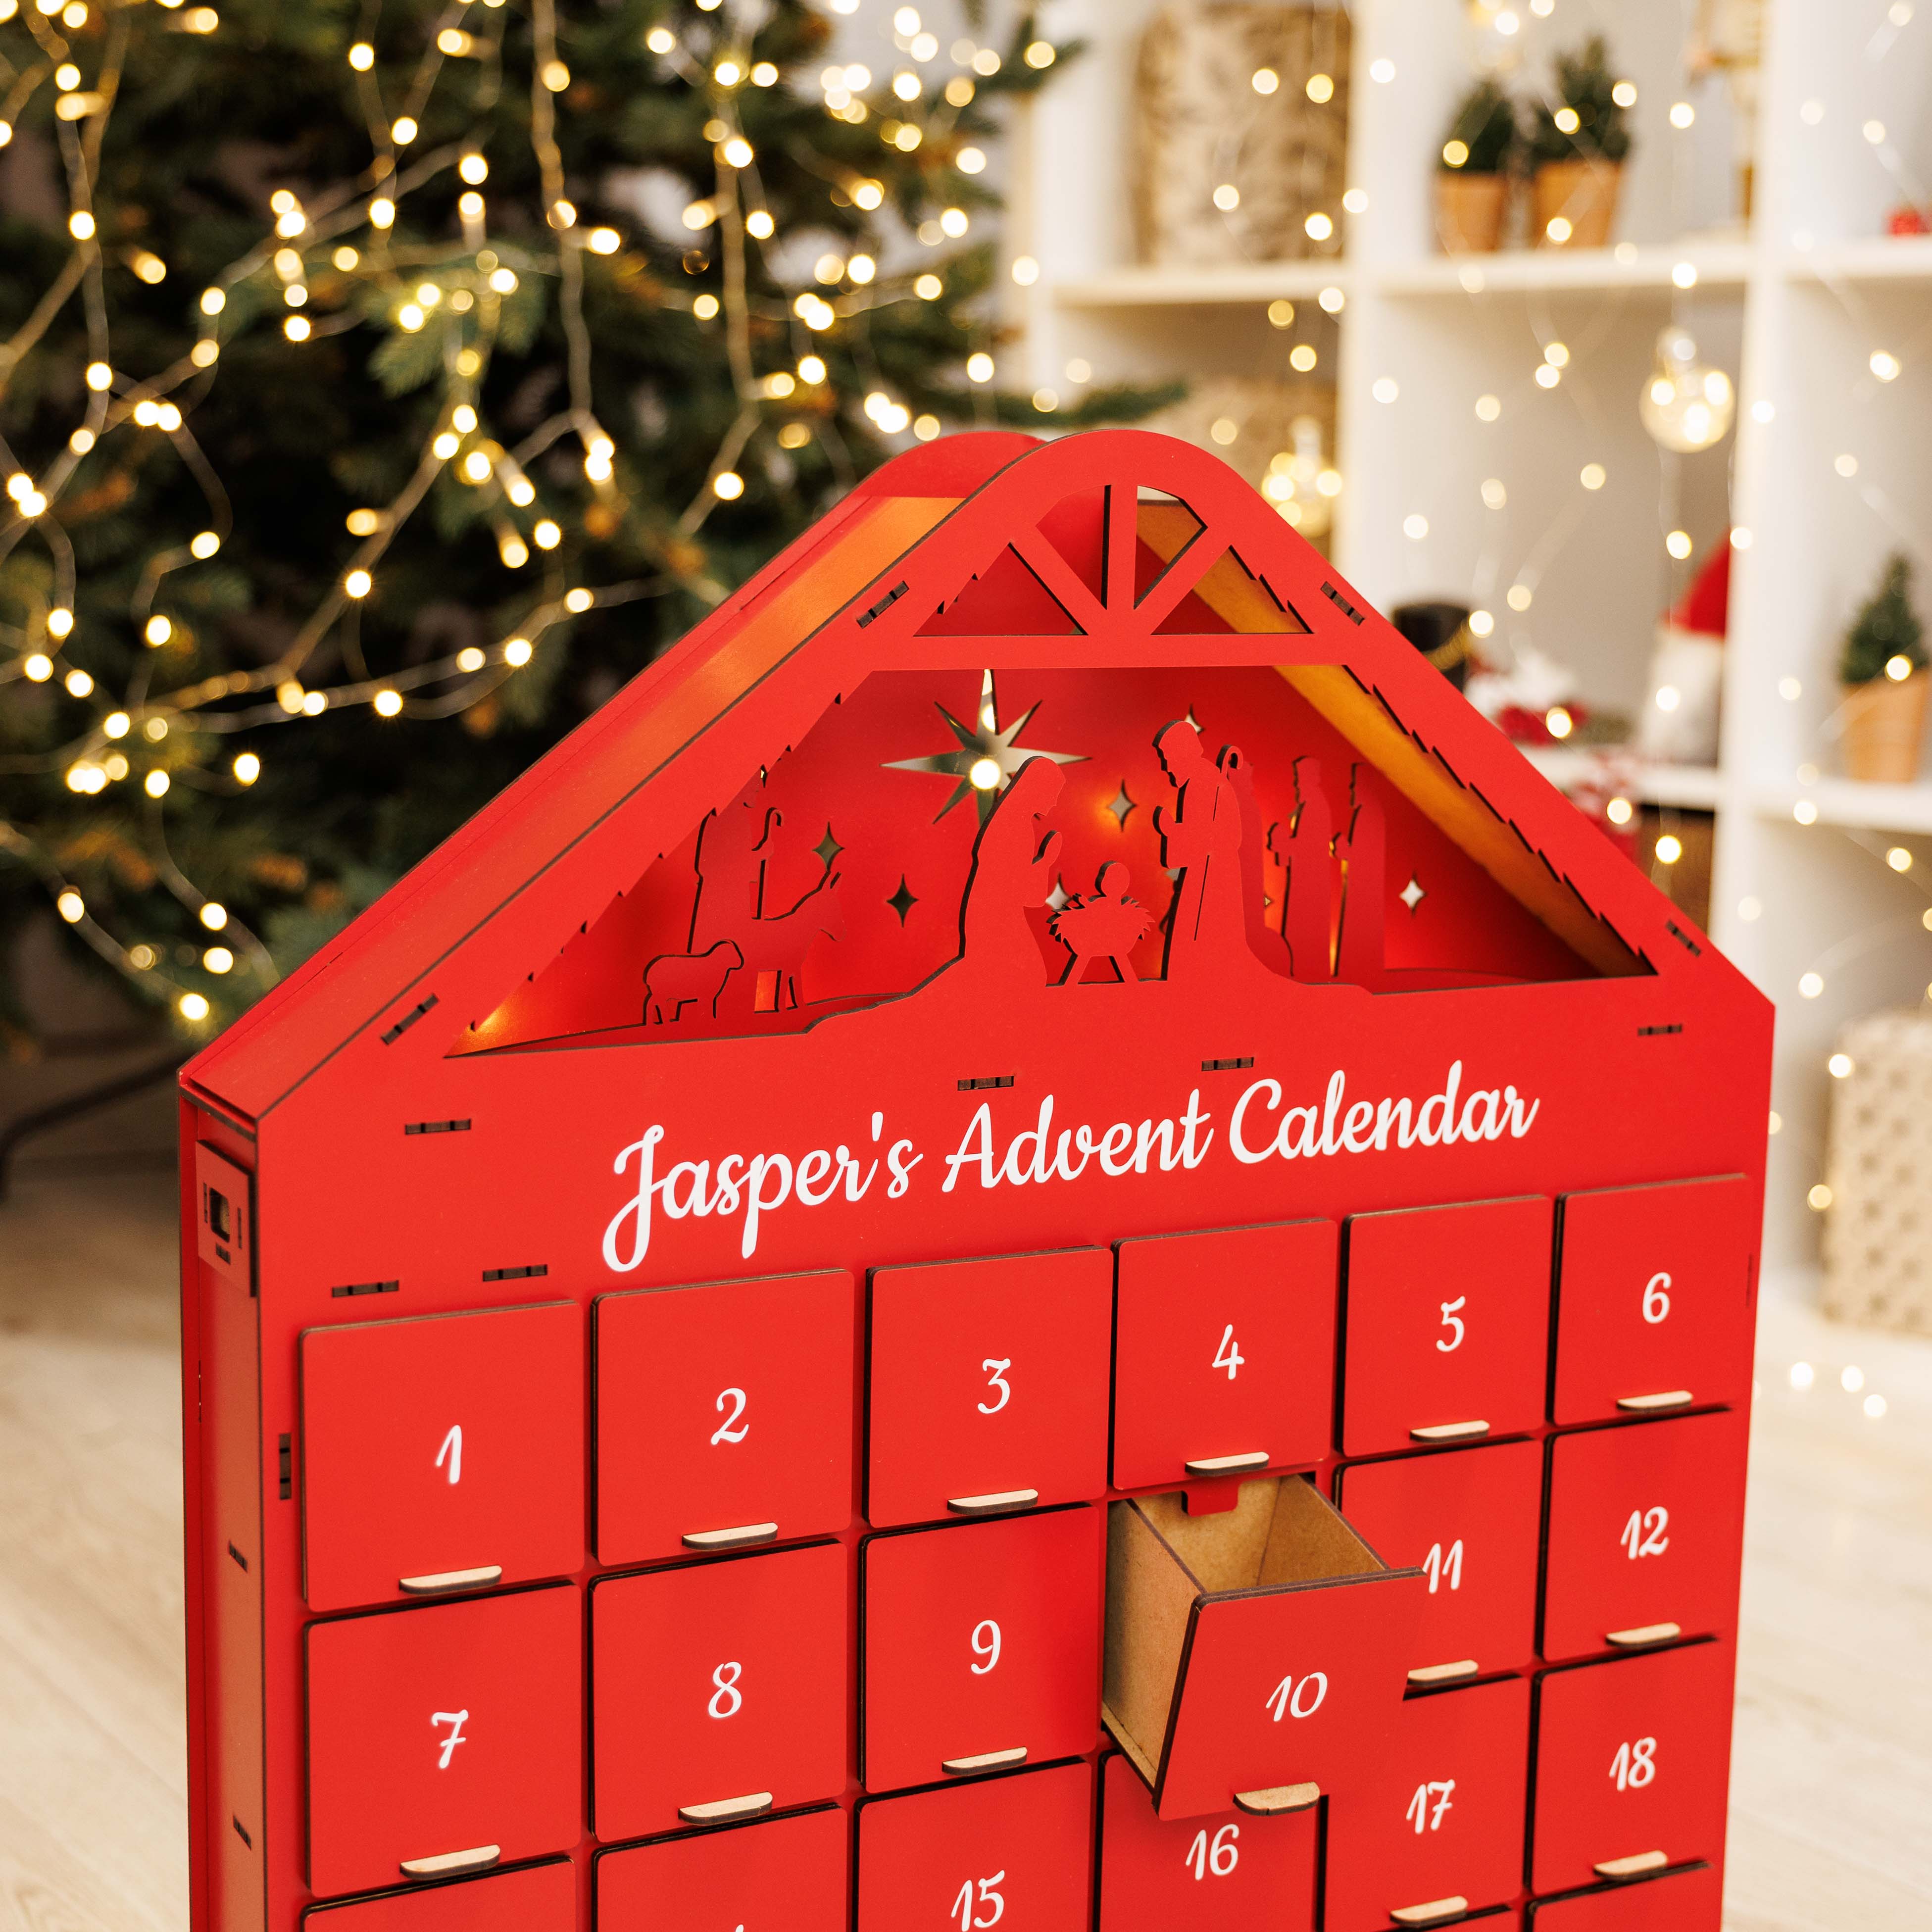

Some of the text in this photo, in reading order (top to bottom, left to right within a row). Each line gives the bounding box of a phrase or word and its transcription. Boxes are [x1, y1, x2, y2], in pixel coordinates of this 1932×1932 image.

[602, 1060, 1540, 1273] Jasper's Advent Calendar
[1437, 1296, 1465, 1351] 5
[1643, 1272, 1671, 1323] 6
[1212, 1324, 1244, 1380] 4
[978, 1358, 1011, 1414] 3
[710, 1387, 749, 1445] 2
[435, 1425, 462, 1485] 1
[1621, 1506, 1669, 1559] 12
[1422, 1539, 1463, 1593] 11
[971, 1620, 1001, 1674] 9
[708, 1662, 742, 1719] 8
[1266, 1672, 1328, 1722] 10
[431, 1709, 469, 1769] 7
[1609, 1737, 1656, 1790] 18
[1406, 1780, 1455, 1833] 17
[1186, 1824, 1239, 1880] 16
[951, 1870, 1005, 1932] 15
